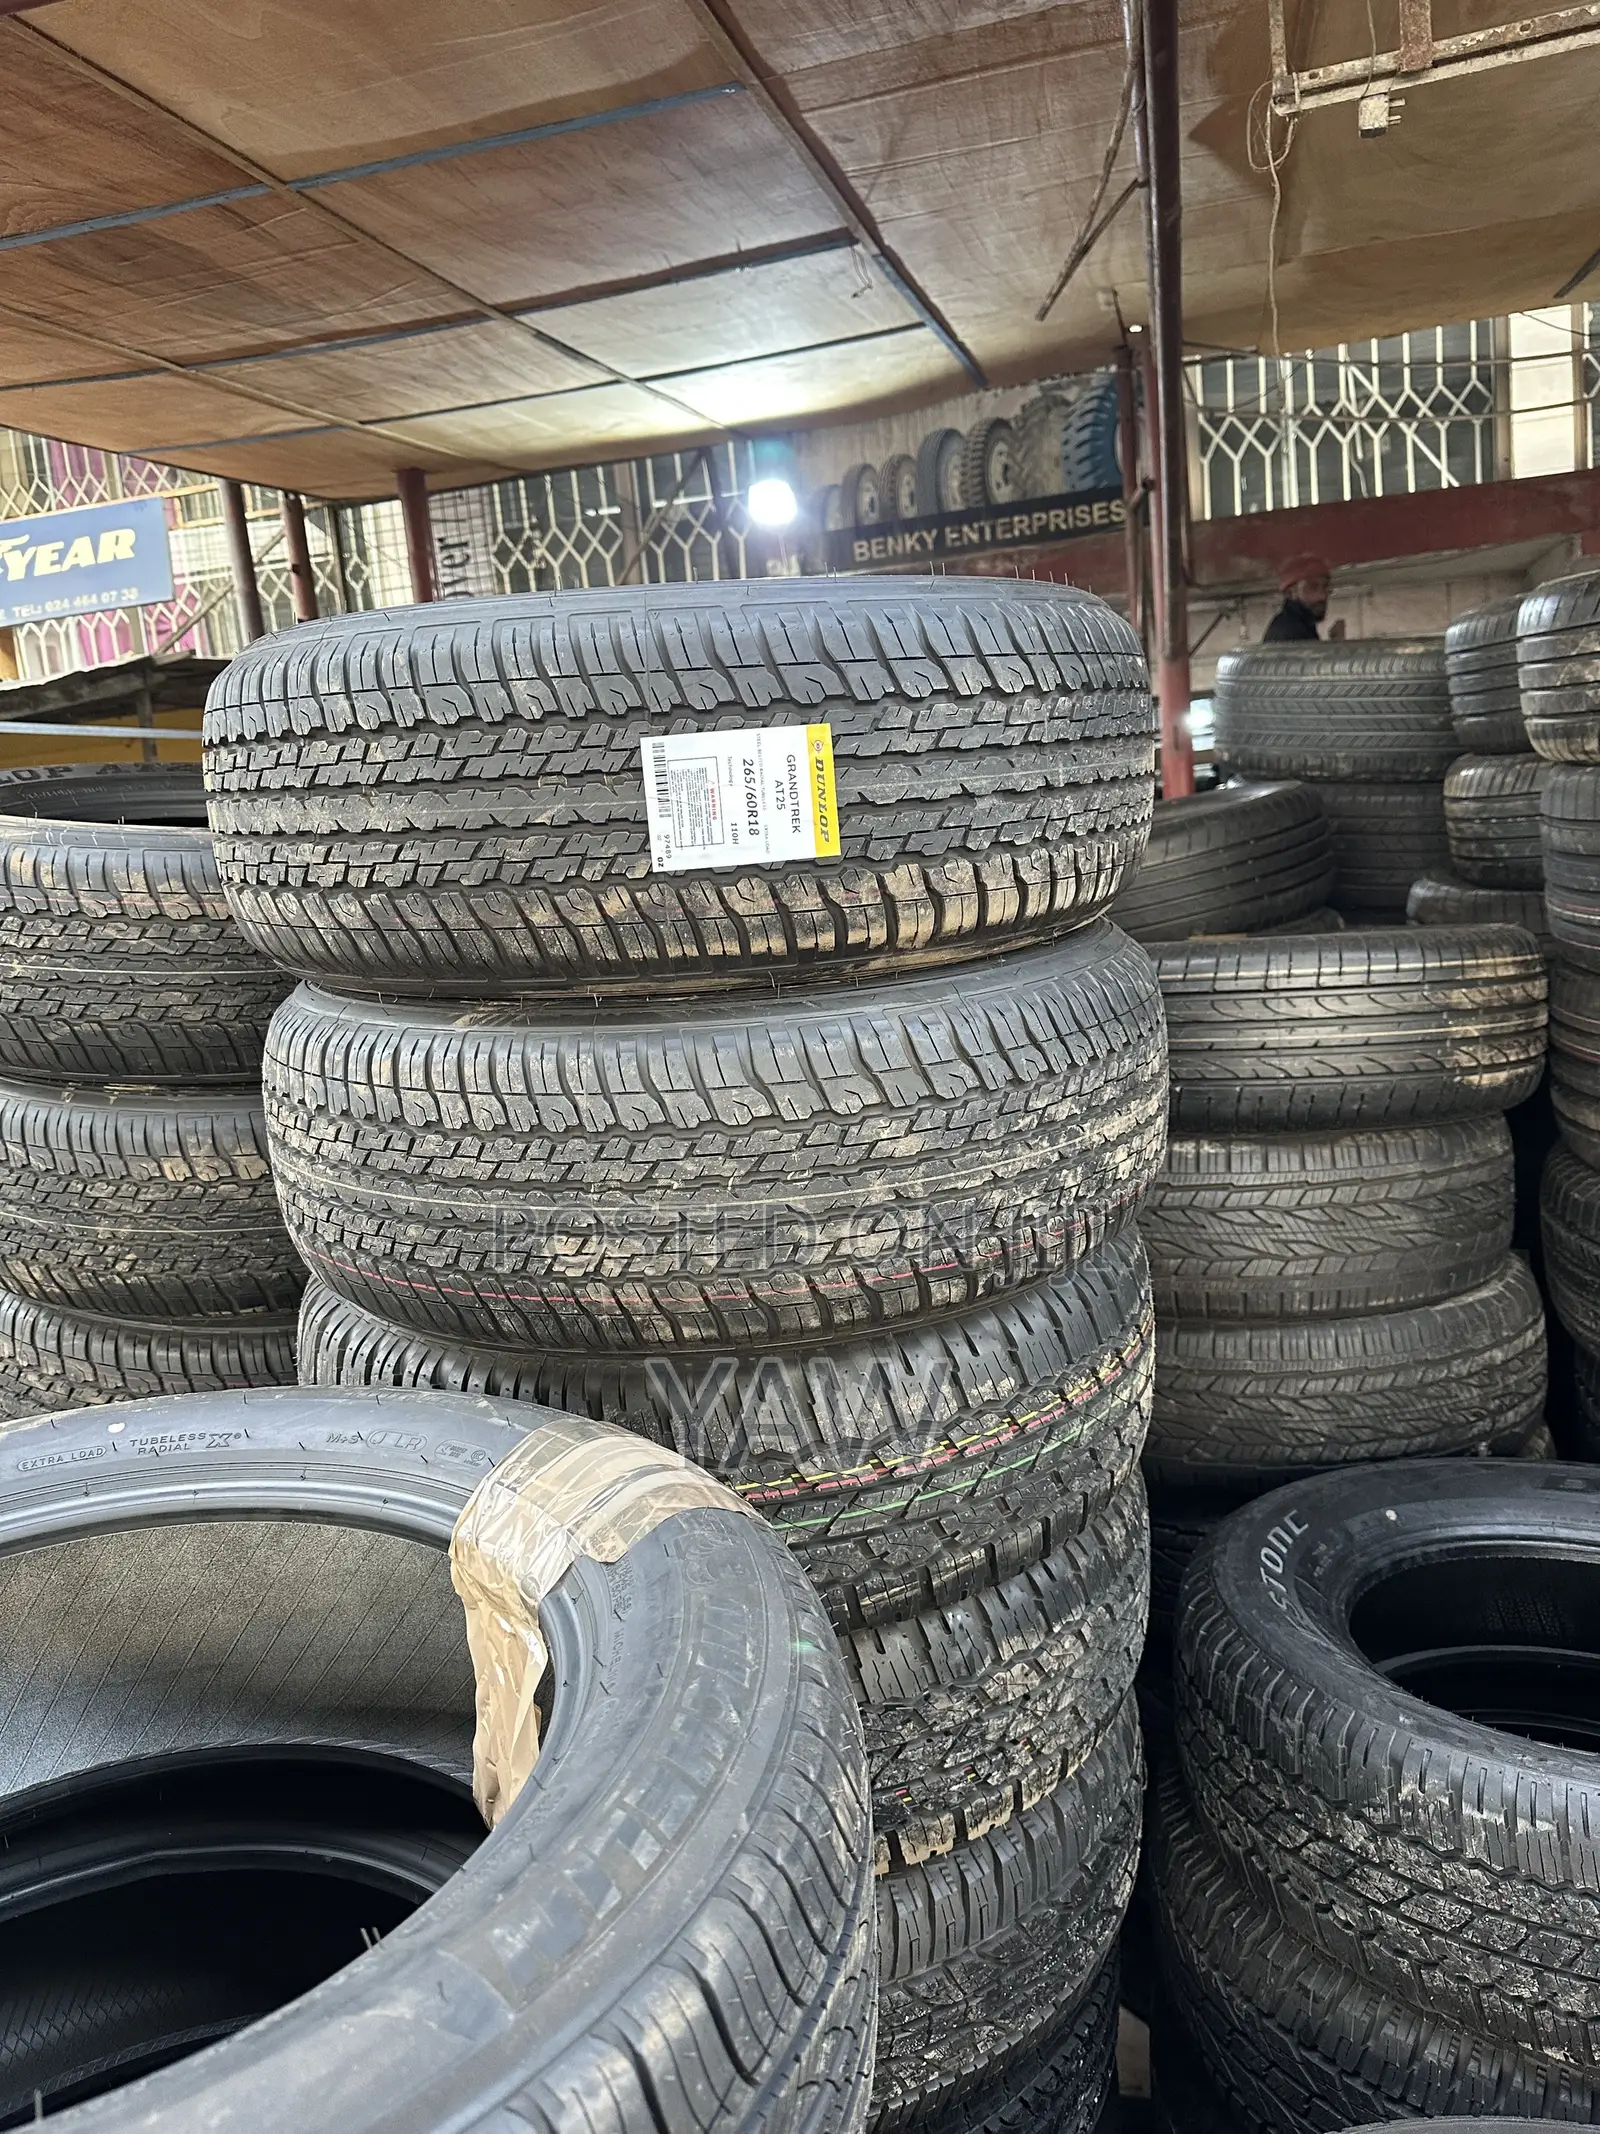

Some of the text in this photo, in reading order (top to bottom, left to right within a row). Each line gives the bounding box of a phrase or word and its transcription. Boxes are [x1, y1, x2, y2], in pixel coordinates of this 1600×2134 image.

[853, 500, 1127, 562] BENKY ENTERPRISES
[0, 528, 136, 581] YEAR
[96, 763, 204, 775] AT2
[743, 758, 760, 836] 265/60R18
[775, 780, 786, 811] AT25
[786, 754, 801, 834] GRANDTREK
[815, 756, 830, 843] DUNLOP
[731, 822, 739, 845] 110H
[664, 834, 672, 859] 97489
[129, 1433, 206, 1447] TUBELESS
[137, 1443, 191, 1455] RADIAL
[325, 1431, 359, 1444] M+S
[22, 1447, 104, 1470] EXTRA LOAD
